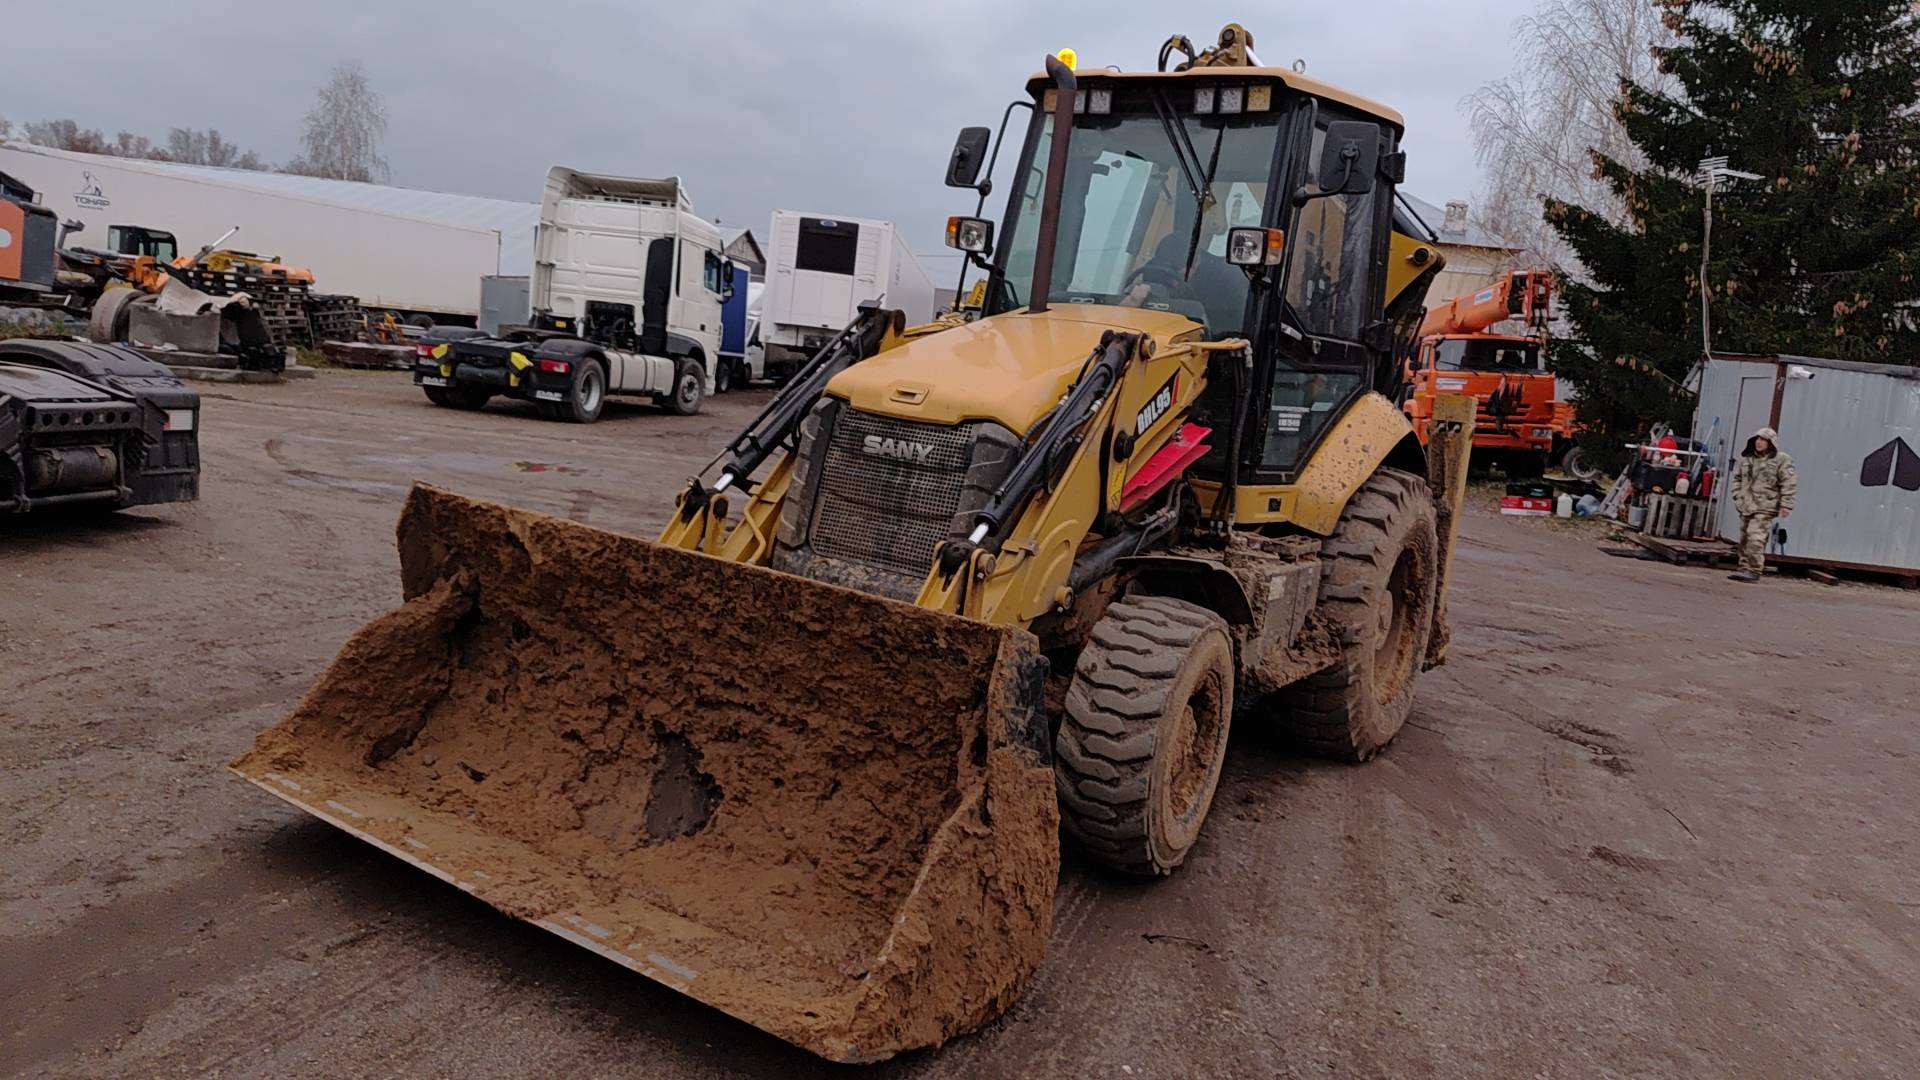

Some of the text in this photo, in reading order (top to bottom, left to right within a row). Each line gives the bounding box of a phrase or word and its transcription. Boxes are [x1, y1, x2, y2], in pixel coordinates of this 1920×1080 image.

[74, 195, 111, 207] ТОНАР
[1136, 386, 1171, 436] BHL95
[863, 435, 935, 463] SANY
